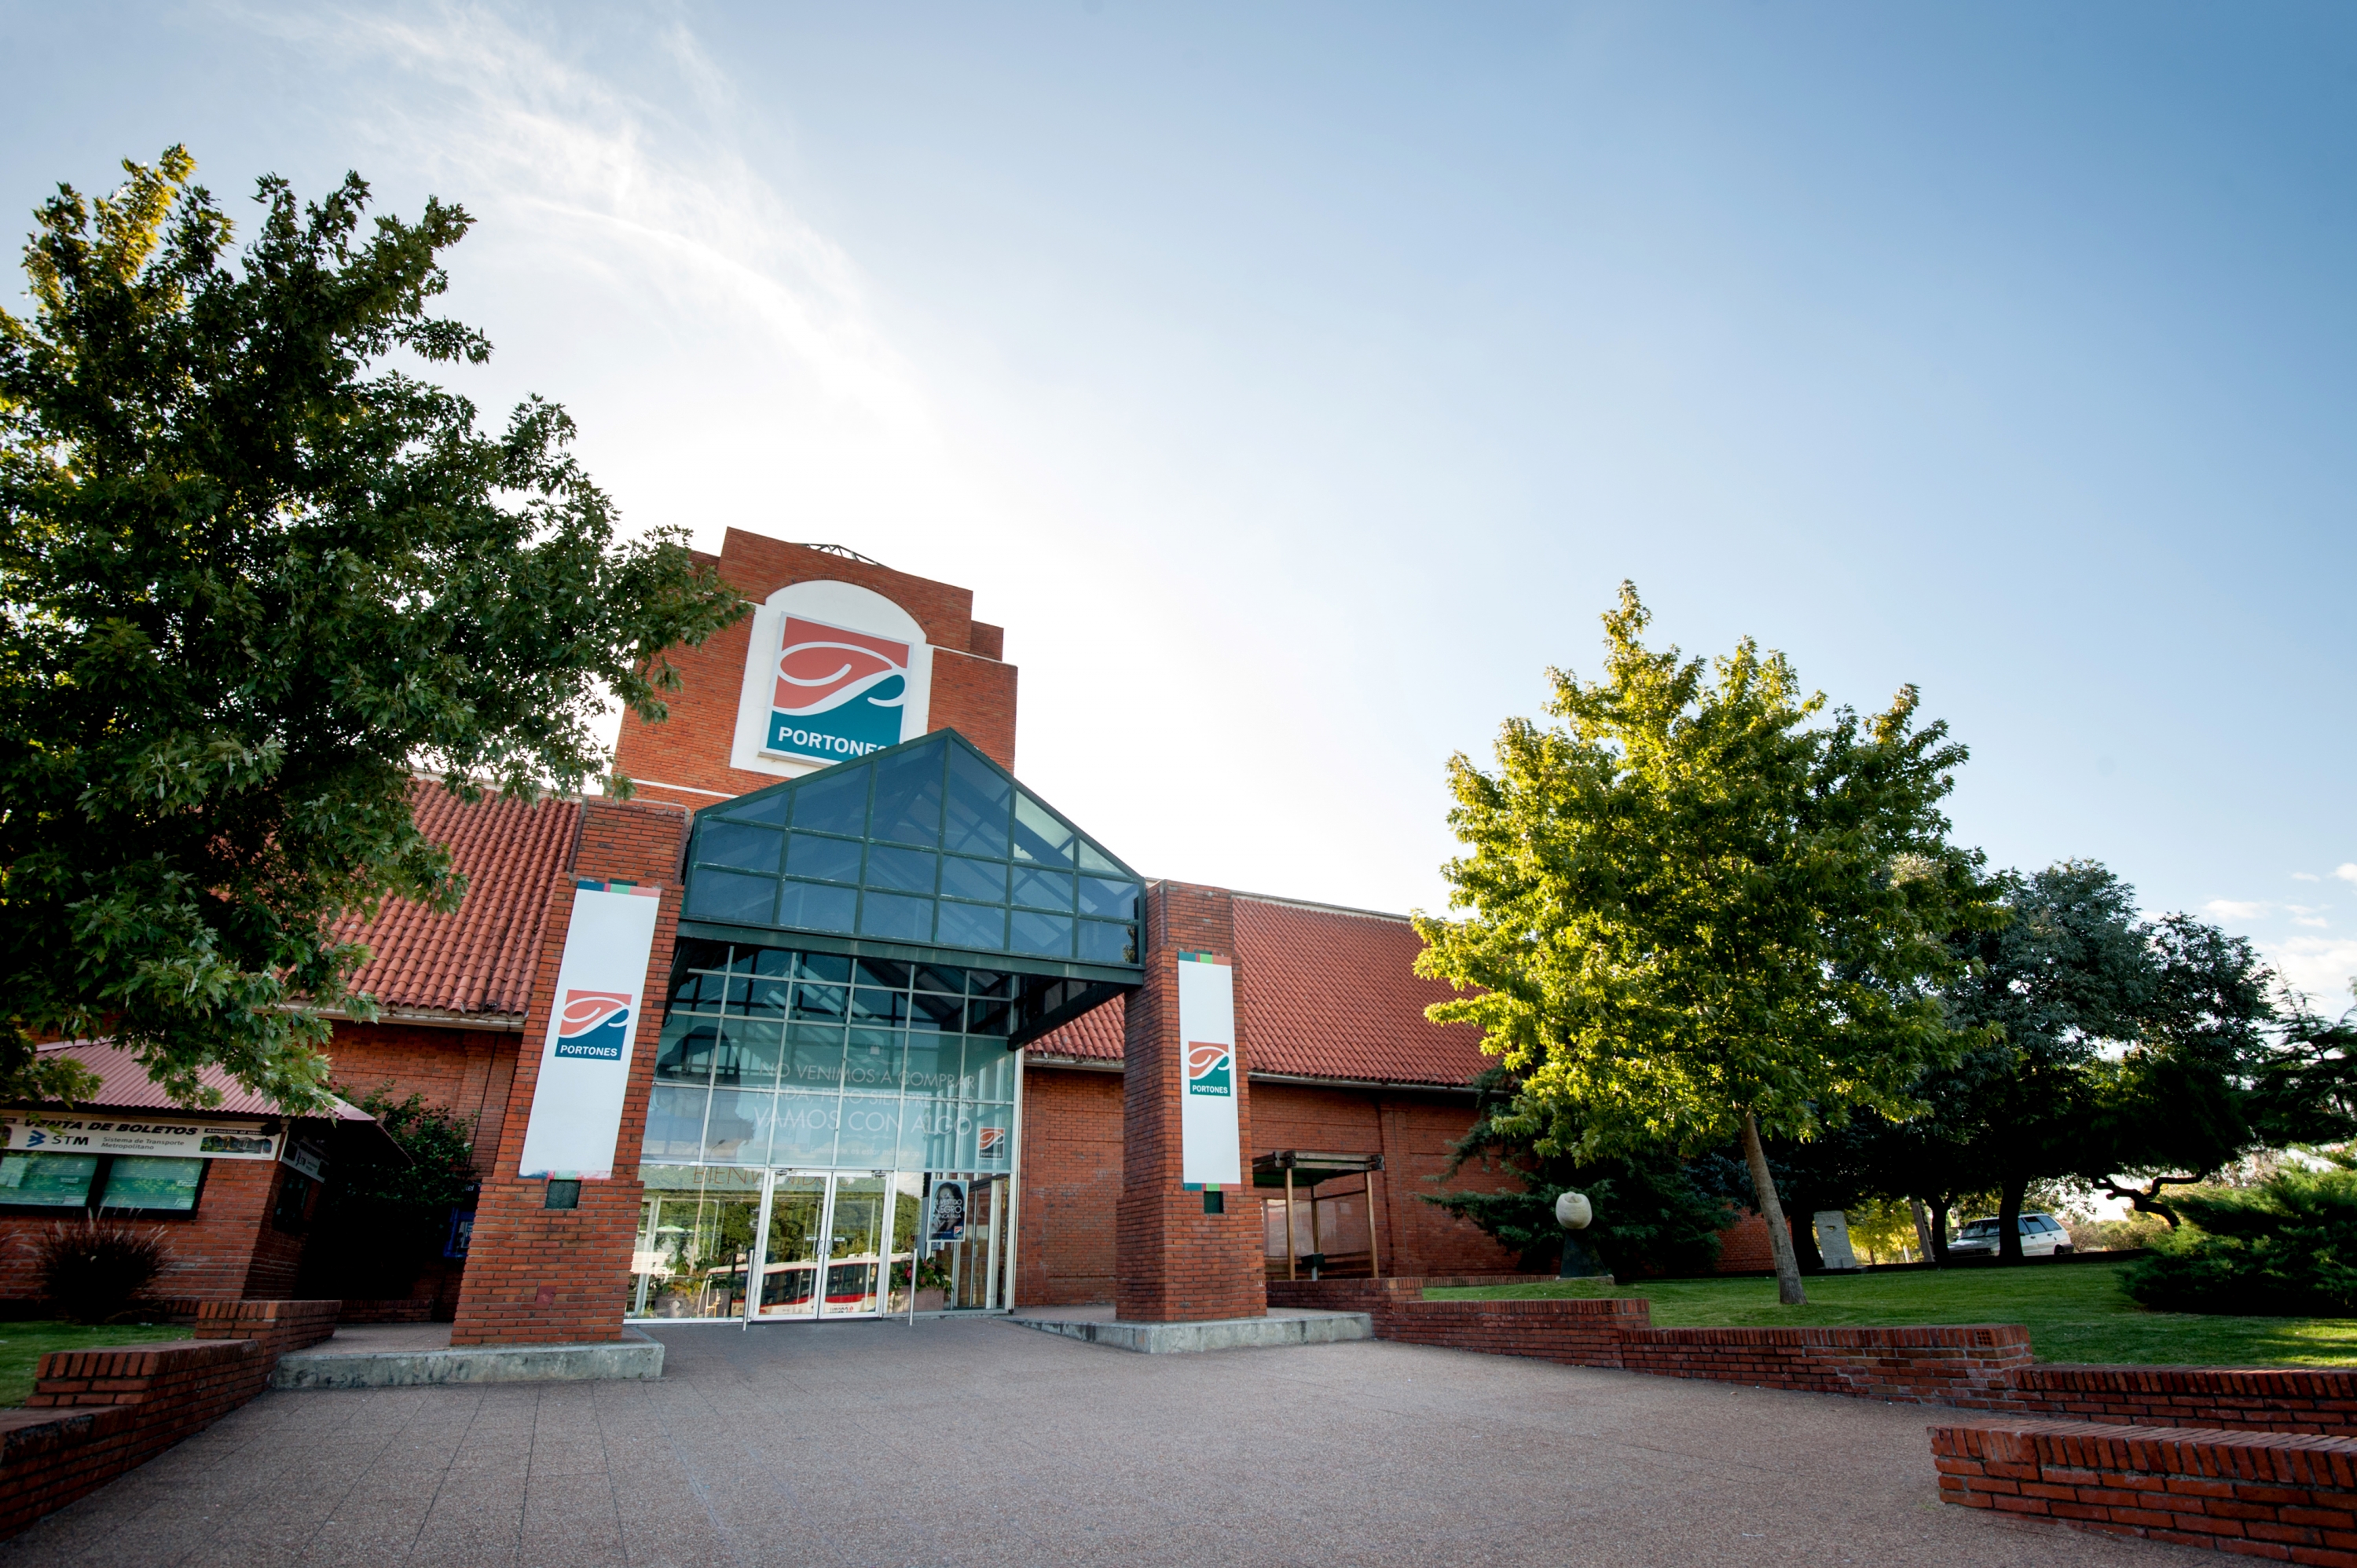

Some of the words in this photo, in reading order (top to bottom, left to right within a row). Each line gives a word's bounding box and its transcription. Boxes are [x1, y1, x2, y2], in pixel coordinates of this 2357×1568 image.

[560, 1045, 618, 1057] PORTONES
[759, 1062, 790, 1078] NO
[797, 1064, 875, 1083] VENIMOS
[880, 1070, 893, 1084] A
[898, 1071, 974, 1090] COMPRAR
[1192, 1085, 1228, 1094] PORTONES
[757, 1084, 813, 1105] NADA,
[821, 1087, 864, 1105] PERO
[869, 1090, 933, 1108] SIEMPRE
[938, 1094, 974, 1110] NOS
[754, 1106, 839, 1130] VAMOS
[848, 1111, 903, 1132] CON
[911, 1115, 972, 1136] ALGO
[87, 1122, 114, 1131] DE
[115, 1123, 199, 1135] BOLETOS
[51, 1135, 89, 1145] STM
